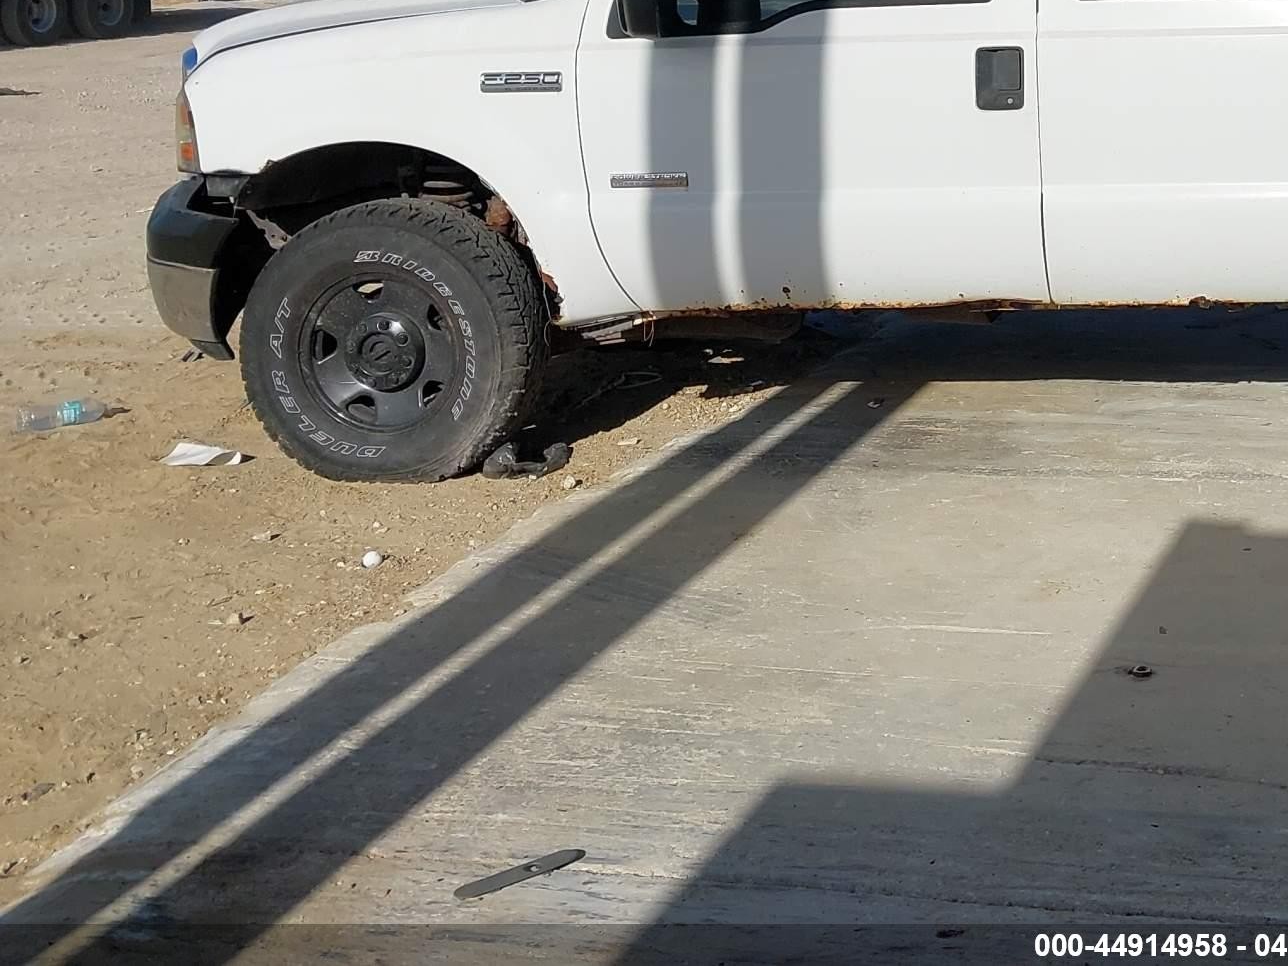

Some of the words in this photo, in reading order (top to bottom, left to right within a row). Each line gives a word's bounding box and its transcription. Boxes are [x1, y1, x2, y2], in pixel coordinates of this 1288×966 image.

[270, 297, 292, 358] A/T
[353, 250, 476, 421] BRIDGESTONE
[271, 369, 387, 458] DUELER
